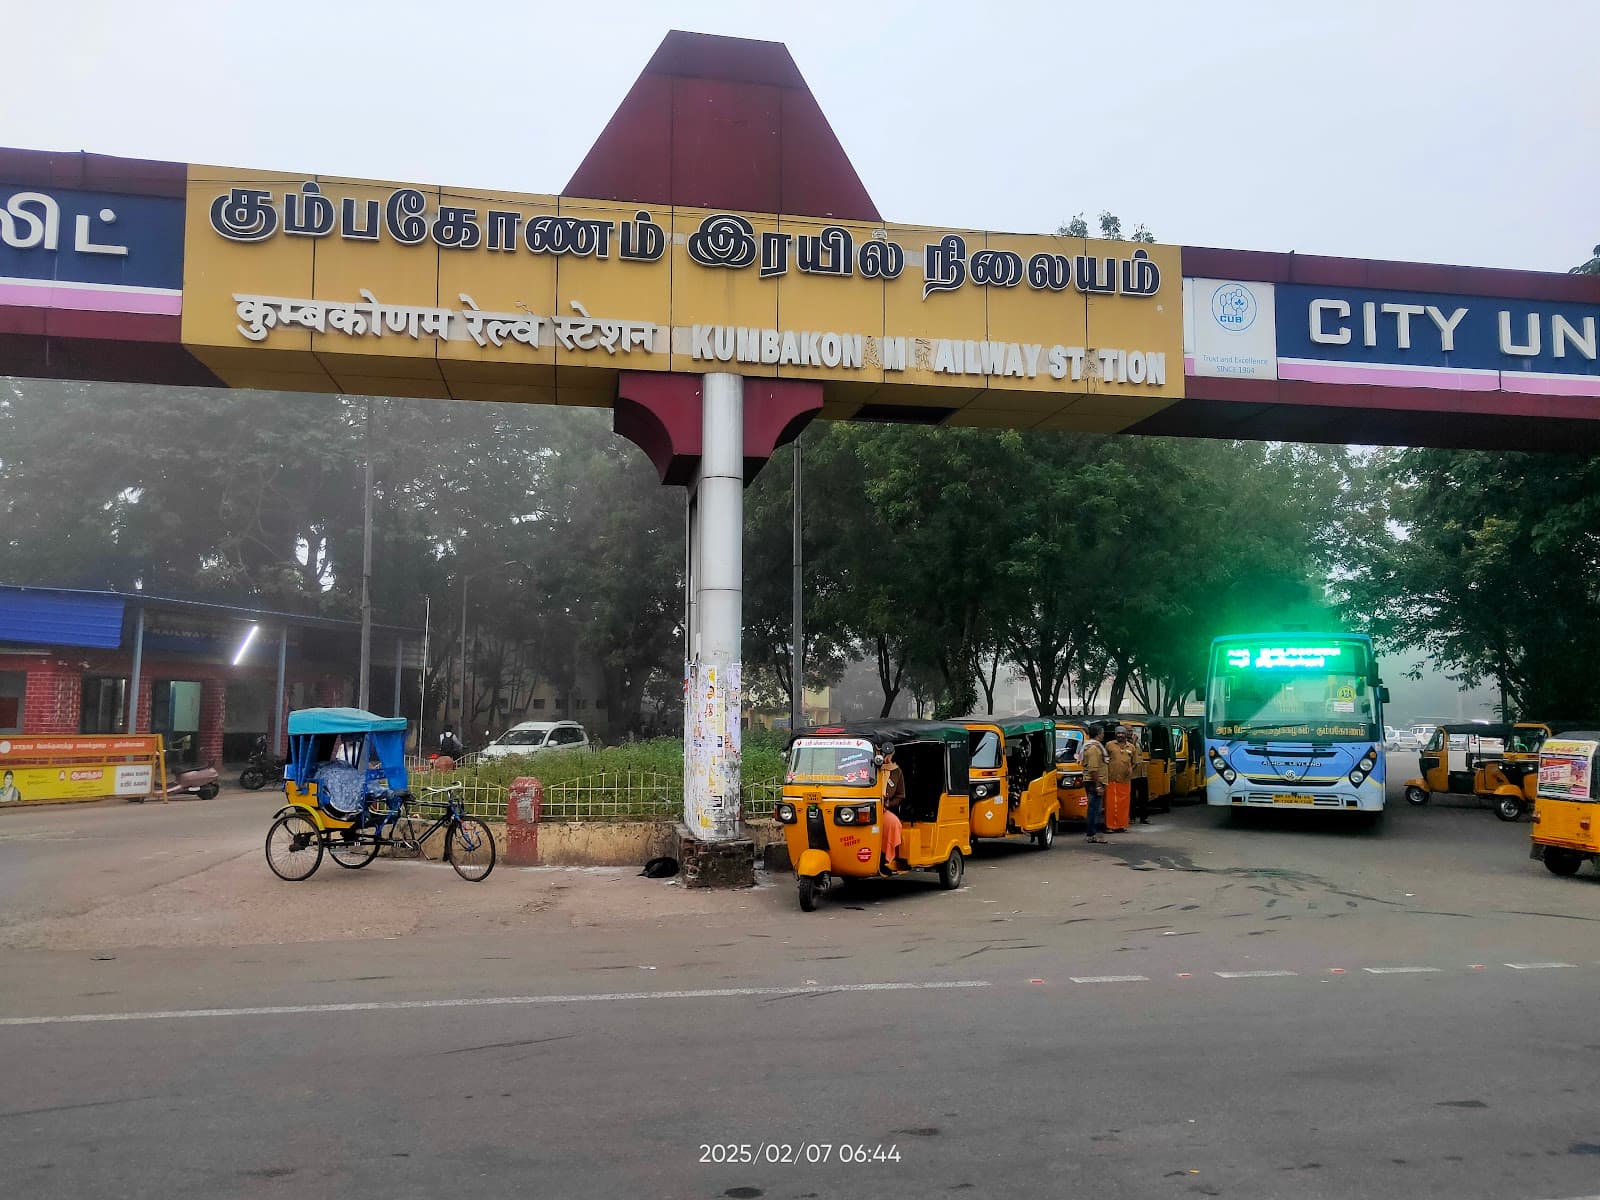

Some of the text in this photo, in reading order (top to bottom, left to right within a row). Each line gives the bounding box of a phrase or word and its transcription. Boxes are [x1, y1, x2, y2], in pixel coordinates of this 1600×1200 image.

[209, 181, 665, 262] கும்பகோணம்
[923, 234, 1161, 301] நிலையம்
[232, 288, 455, 341] कुम्बकोणम
[551, 300, 658, 355] स्टेशन
[1220, 315, 1242, 323] CUB
[1308, 298, 1597, 361] CITY UN
[691, 323, 1166, 386] KUMBAKONM AILWAY STTION
[1216, 365, 1236, 373] SINCE
[1220, 355, 1233, 363] and
[1234, 356, 1269, 365] Excellence
